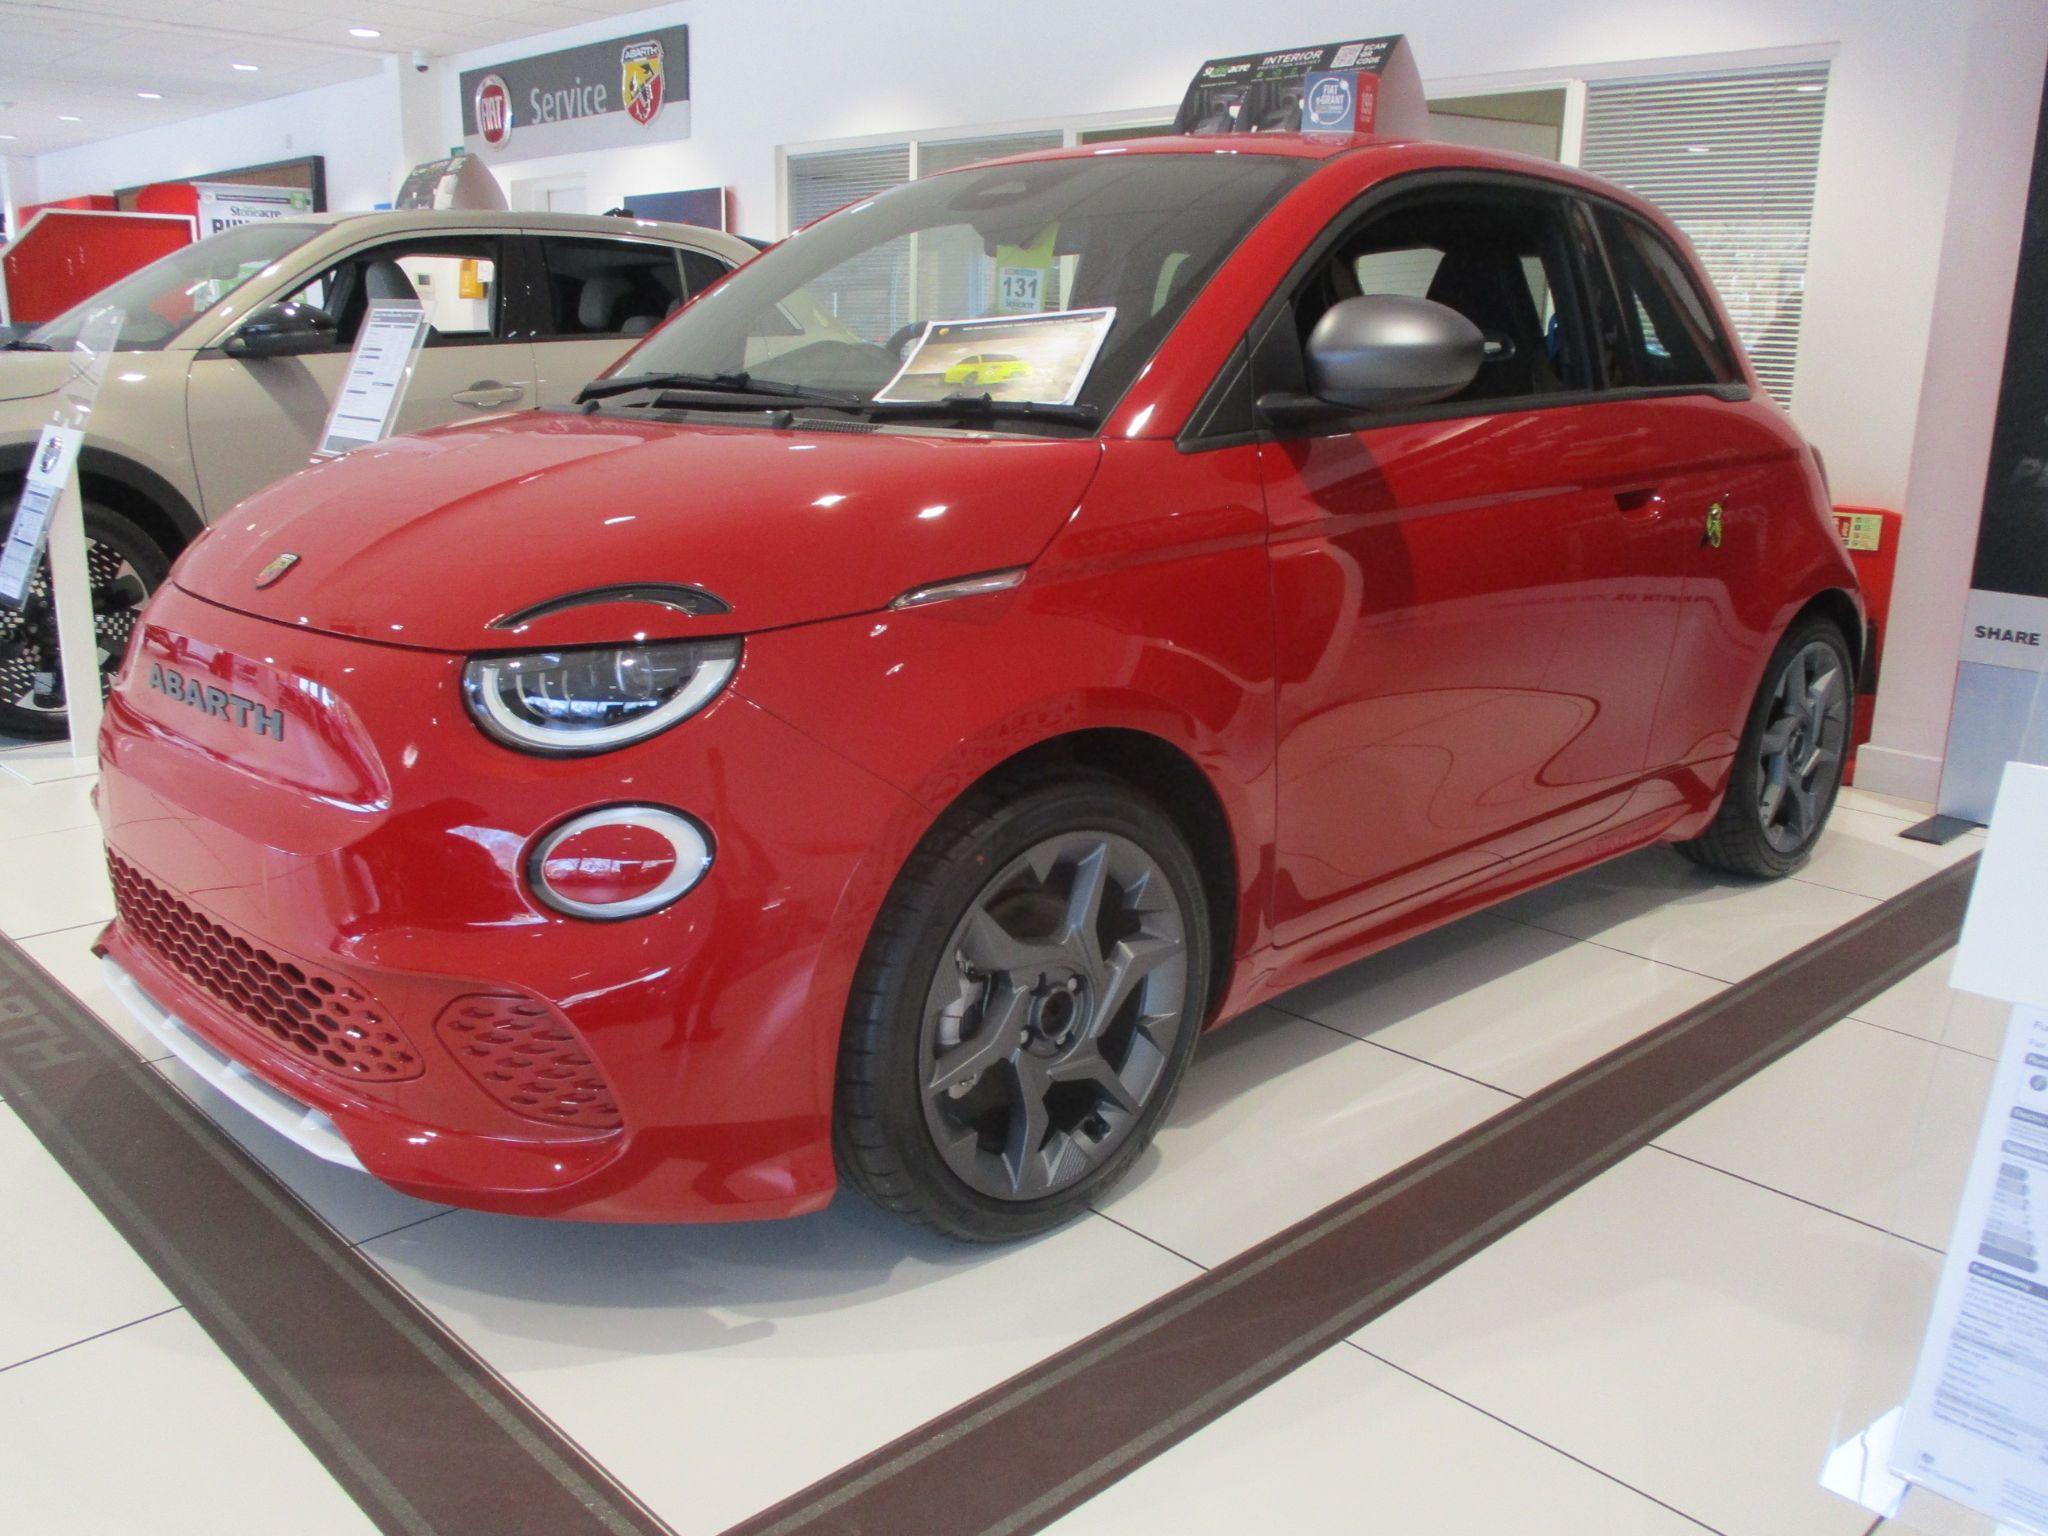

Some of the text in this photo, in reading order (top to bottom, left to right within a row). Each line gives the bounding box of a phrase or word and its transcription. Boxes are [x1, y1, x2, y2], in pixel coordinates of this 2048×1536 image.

[624, 46, 658, 59] ABARTH
[1262, 50, 1324, 65] INTERIOR
[530, 76, 608, 124] Service
[1323, 84, 1339, 95] FIAT
[481, 95, 503, 131] FIAT
[230, 206, 282, 218] Stoneacre
[1003, 277, 1038, 299] 131
[1974, 625, 2041, 646] SHARE
[149, 662, 284, 742] ABARTH
